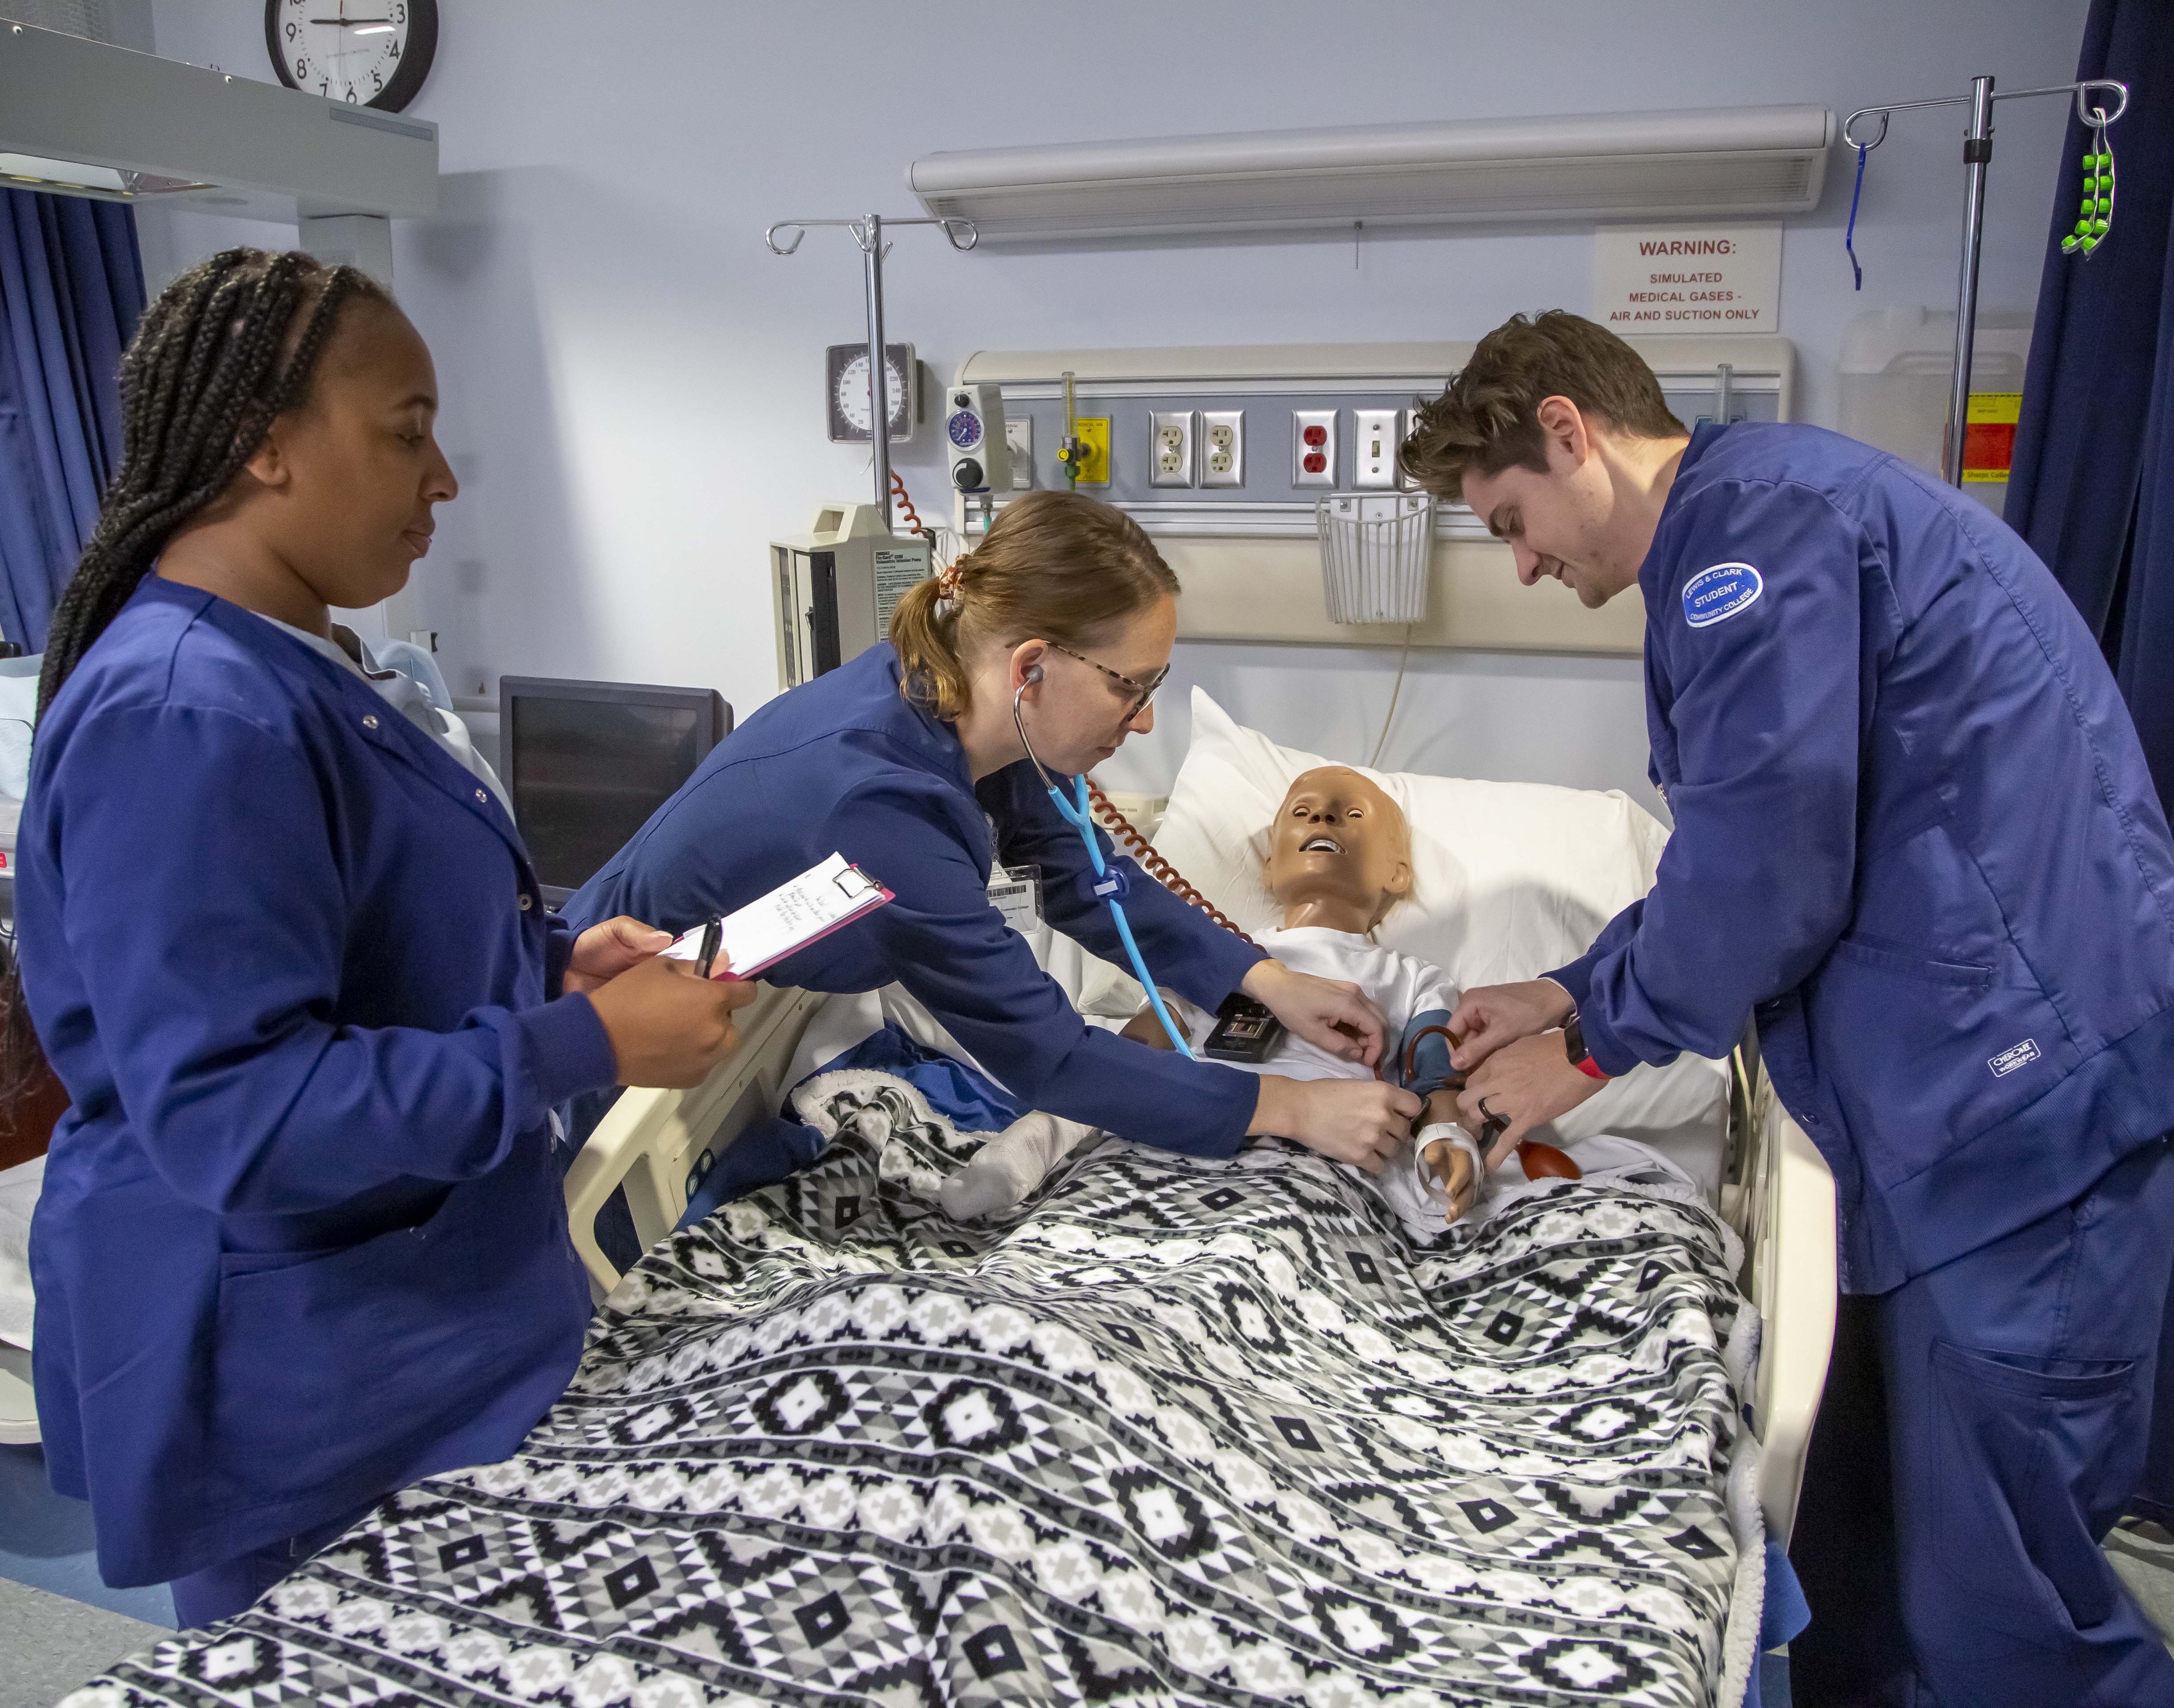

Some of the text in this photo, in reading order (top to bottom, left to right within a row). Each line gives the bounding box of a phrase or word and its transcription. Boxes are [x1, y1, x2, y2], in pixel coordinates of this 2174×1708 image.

[396, 4, 406, 24] 3
[286, 23, 296, 43] 9
[389, 39, 400, 59] 4
[297, 59, 307, 79] 8
[319, 83, 327, 97] 7
[374, 73, 383, 92] 5
[347, 86, 357, 104] 6
[1639, 240, 1736, 256] WARNING:
[1650, 272, 1722, 283] SIMULATED
[1629, 292, 1685, 302] MEDICAL
[1690, 291, 1733, 302] GASES
[1610, 309, 1760, 321] AIR AND SUCTION ONLY
[1686, 579, 1704, 599] LEWIS
[1713, 568, 1743, 579] CLARK
[1690, 587, 1754, 621] COMMUNITY COLLEGE
[1695, 581, 1738, 608] STUDENT
[1993, 1043, 2032, 1066] CHEROKEE
[1999, 1051, 2035, 1072] WORKWEAR
